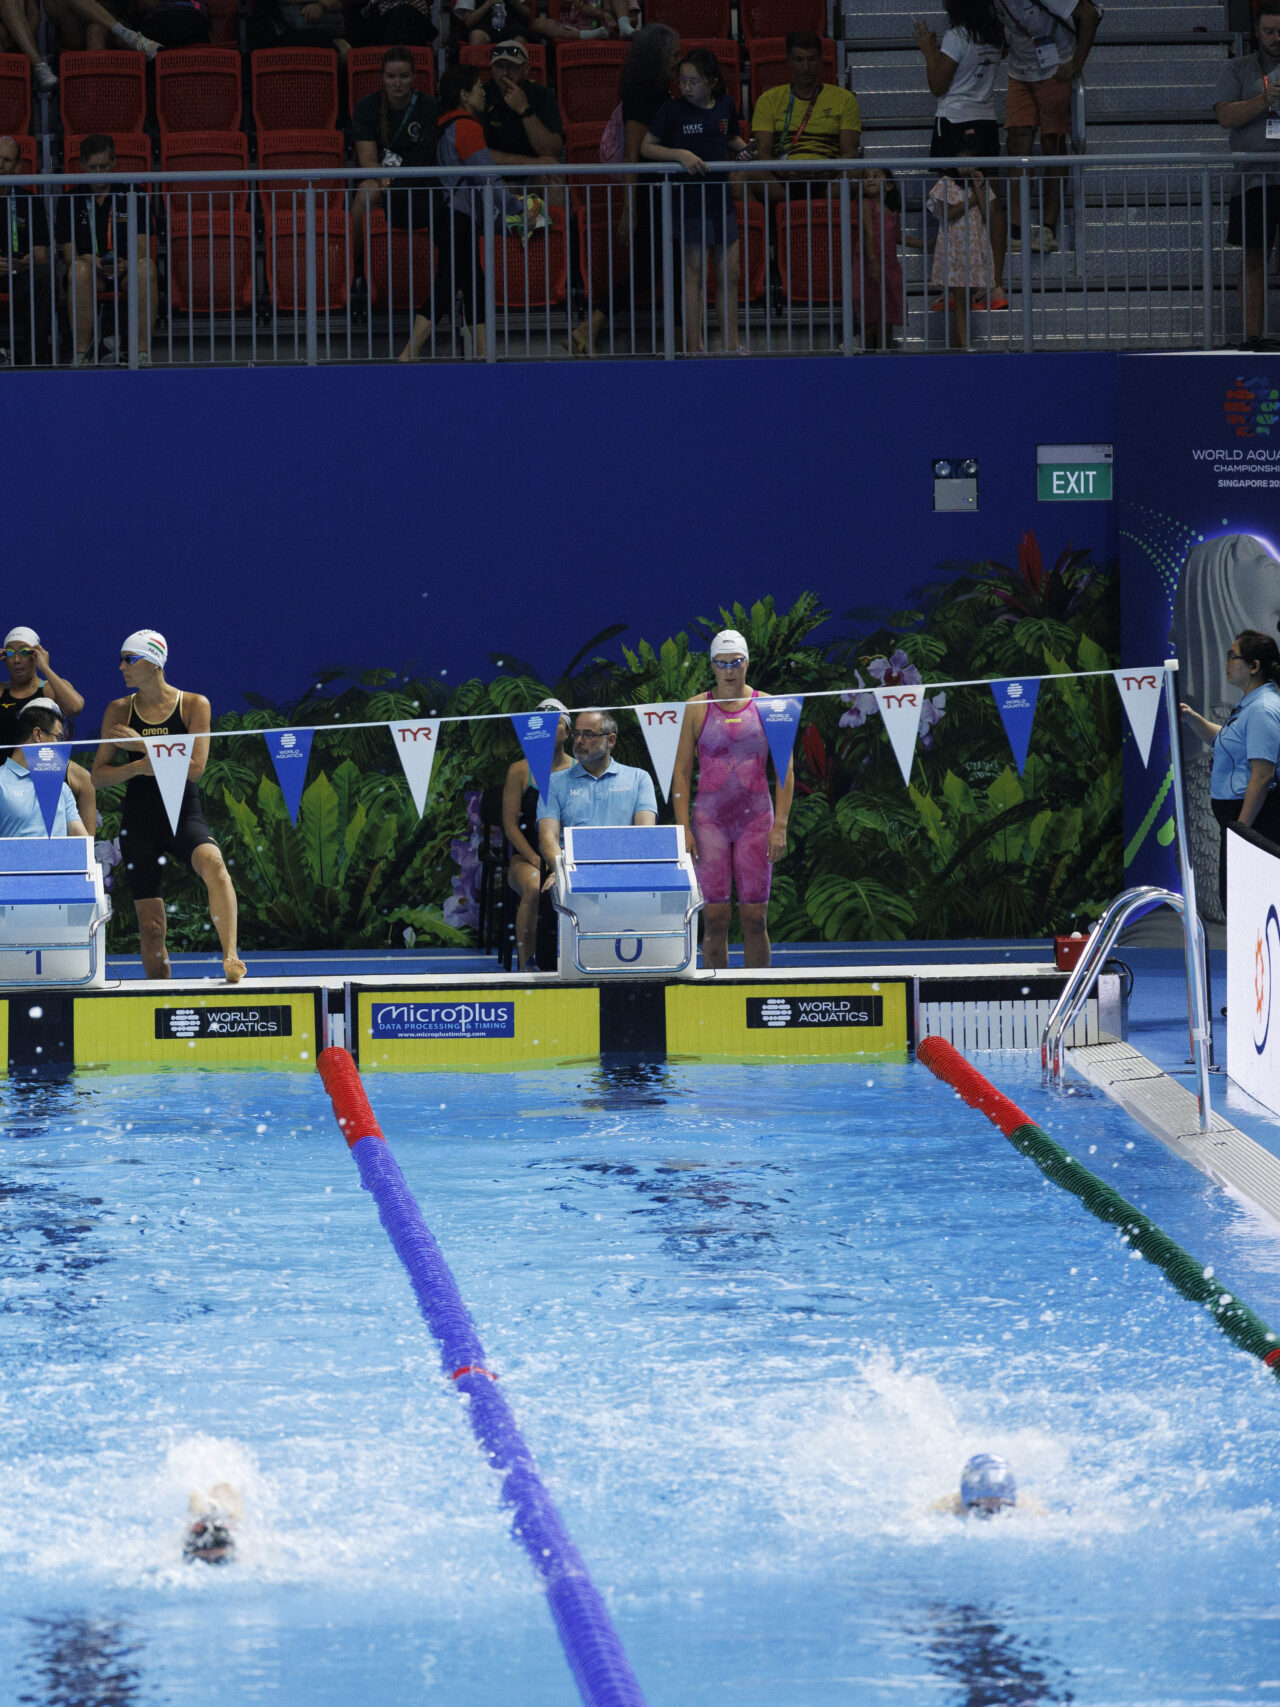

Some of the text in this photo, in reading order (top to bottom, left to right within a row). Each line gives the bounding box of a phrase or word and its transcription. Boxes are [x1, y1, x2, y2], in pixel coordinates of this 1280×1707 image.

[1192, 449, 1243, 461] WORLD
[1213, 464, 1280, 473] CHAMPIONSHI
[1052, 471, 1097, 494] EXIT
[1217, 479, 1269, 488] SINGAPORE
[1122, 675, 1158, 691] TYR
[882, 693, 917, 709] TYR
[644, 710, 677, 726] TYR
[142, 727, 169, 737] arena
[398, 727, 432, 742] TYR
[523, 733, 550, 741] AQUATICS
[152, 742, 186, 758] TYR
[25, 950, 42, 975] 1
[798, 1001, 851, 1011] WORLD
[207, 1011, 259, 1021] WORLD
[798, 1011, 869, 1023] AQUATICS
[207, 1021, 278, 1033] AQUATICS
[404, 1022, 461, 1030] PROCESSING
